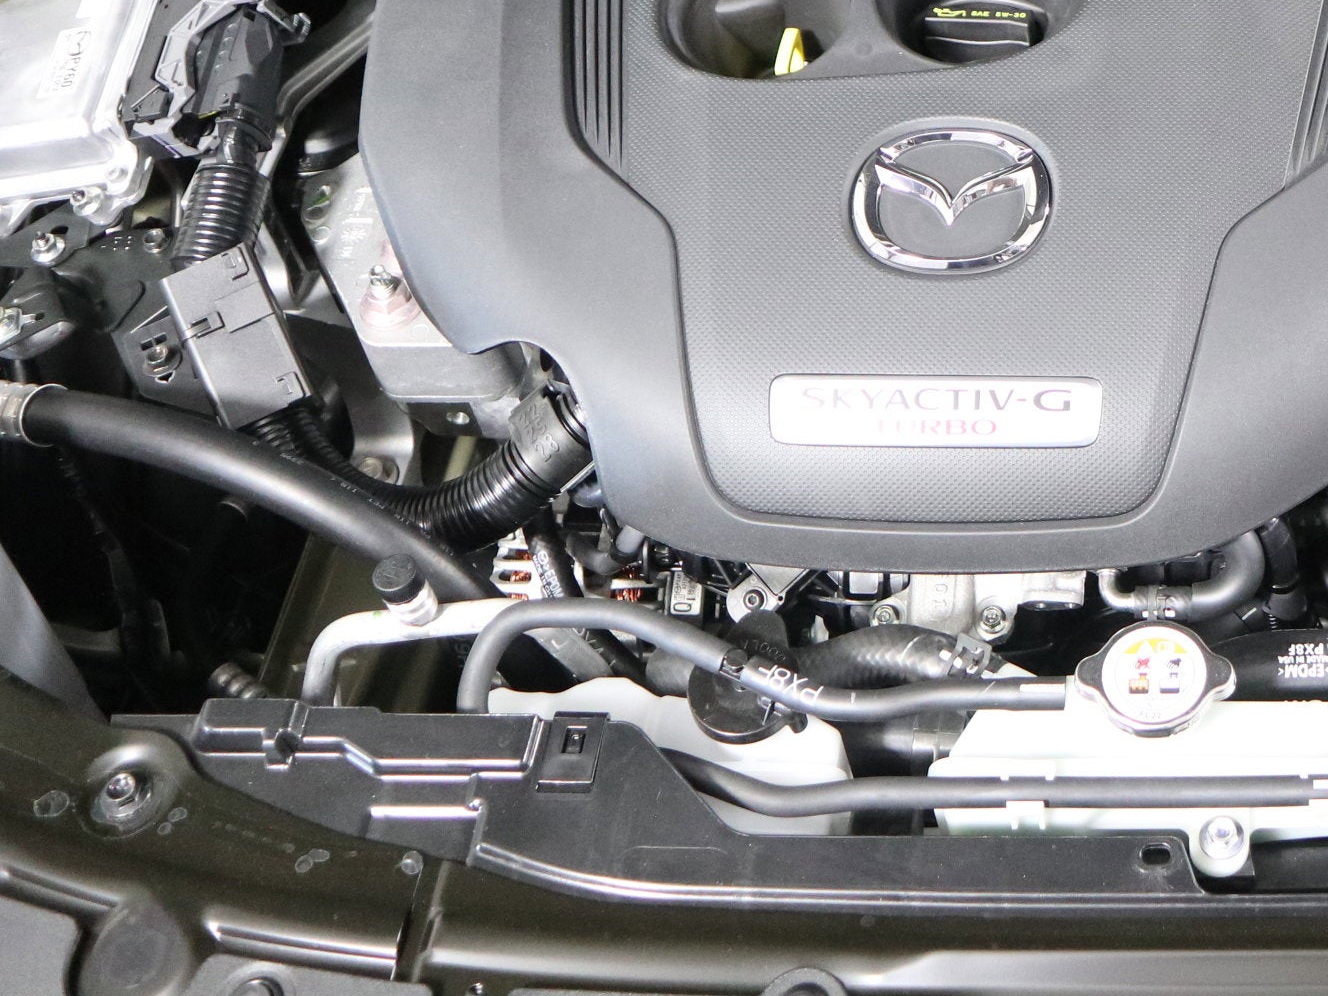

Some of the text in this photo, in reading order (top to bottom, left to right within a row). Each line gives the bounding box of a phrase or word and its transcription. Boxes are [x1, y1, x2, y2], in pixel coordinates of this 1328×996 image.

[995, 11, 1027, 19] 5W-30
[800, 386, 1073, 413] SKYACTIV-G
[876, 418, 998, 437] TURBO
[1288, 642, 1324, 656] PX8F
[757, 665, 825, 706] PX8F
